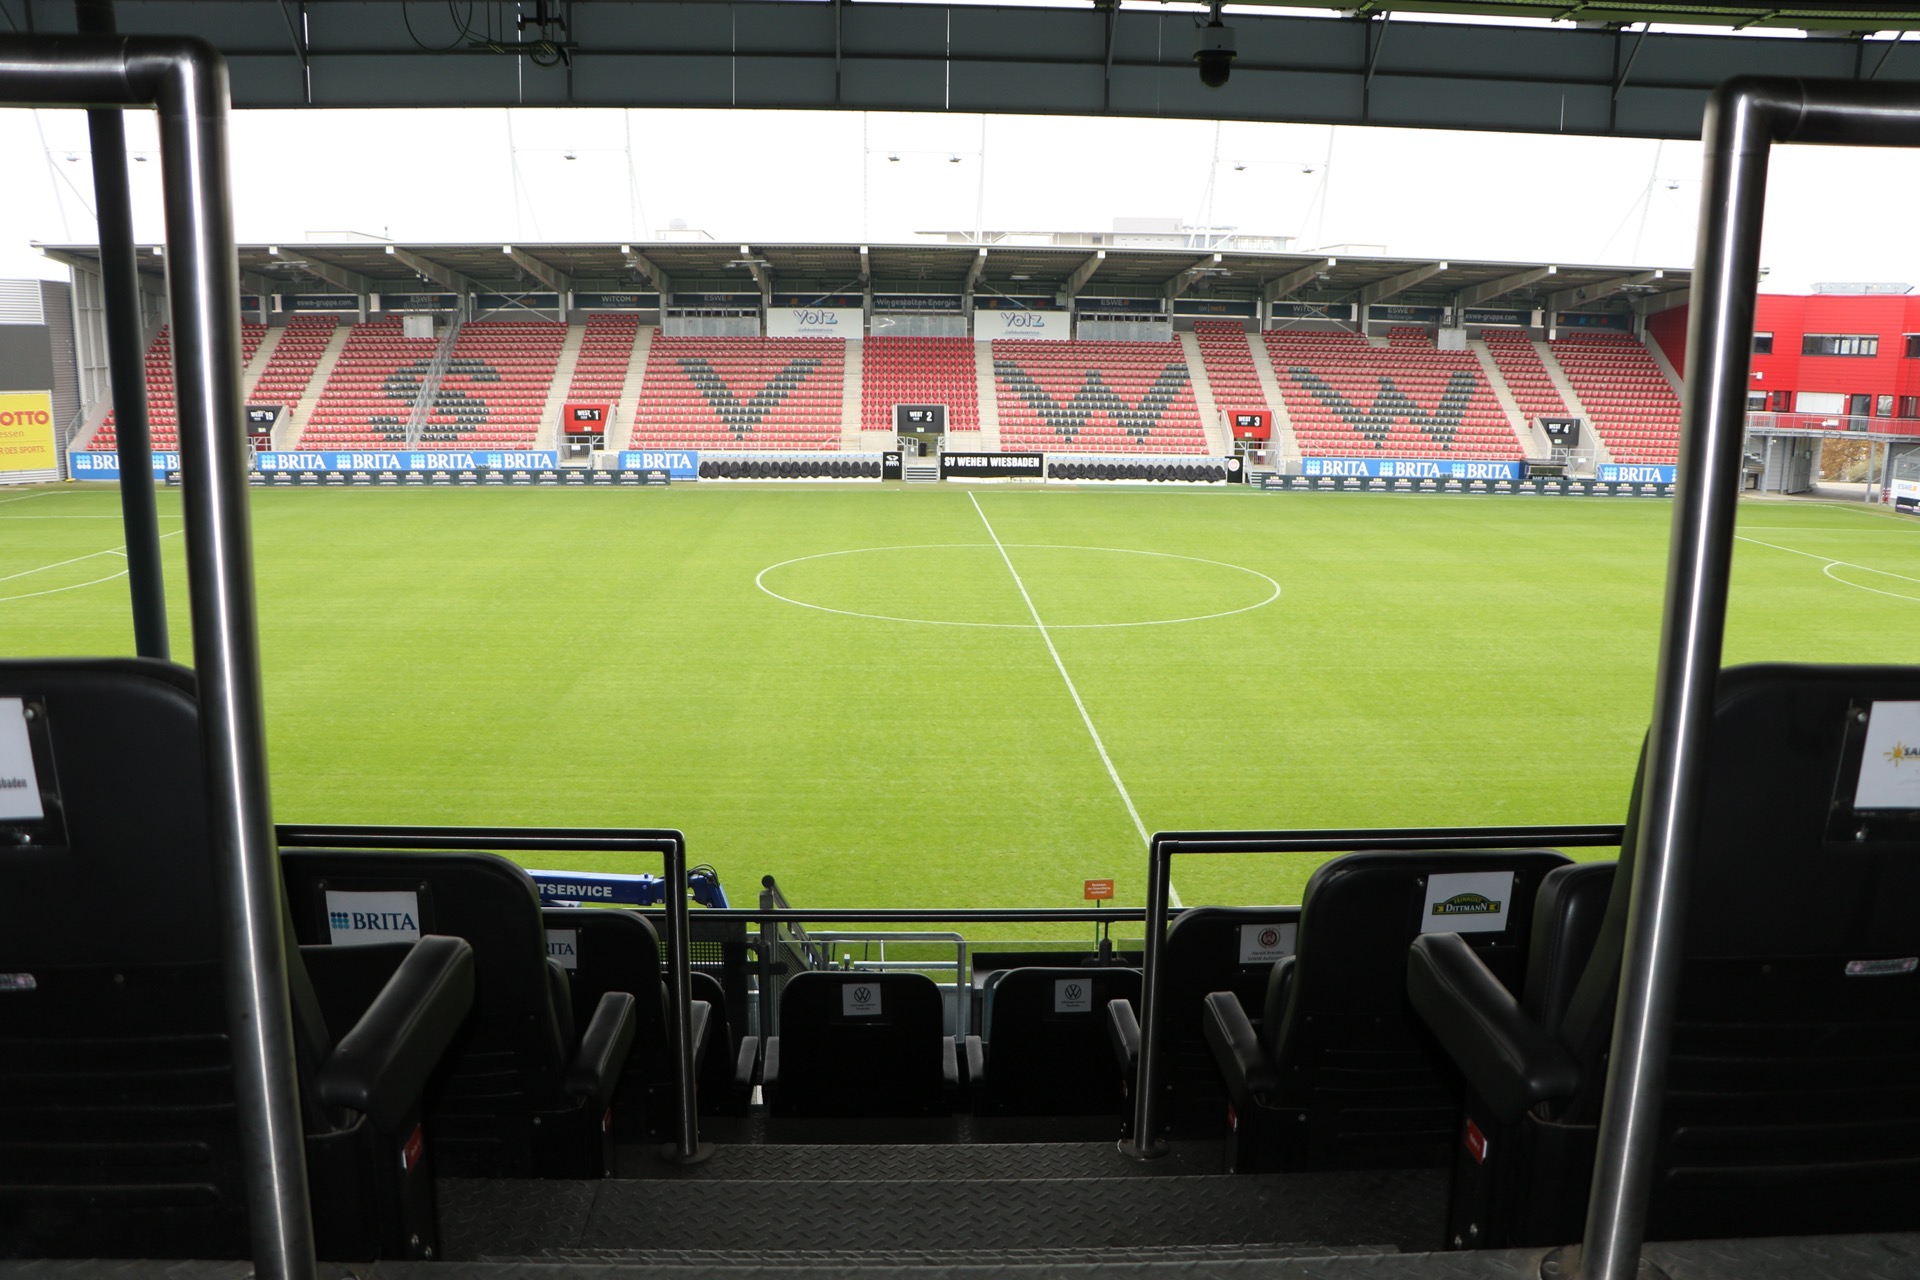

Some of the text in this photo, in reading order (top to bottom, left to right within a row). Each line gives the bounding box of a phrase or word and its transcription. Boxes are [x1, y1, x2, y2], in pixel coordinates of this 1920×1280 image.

[0, 411, 50, 427] OTTO
[926, 411, 933, 422] 2
[1254, 416, 1261, 426] 3
[0, 430, 24, 439] essen
[92, 454, 120, 471] BRI
[278, 454, 327, 469] BRITA
[352, 454, 401, 469] BRITA
[427, 454, 476, 469] BRITA
[504, 453, 553, 468] BRITA
[643, 453, 693, 469] BRITA
[944, 456, 1040, 468] SV WEHEN WIESBADEN
[1322, 461, 1369, 476] BRITA
[1395, 462, 1441, 477] BRITA
[1468, 464, 1512, 479] BRITA
[1619, 466, 1662, 482] BRITA
[538, 884, 612, 898] TSERVICE
[352, 912, 417, 932] BRITA
[545, 943, 575, 955] RITA
